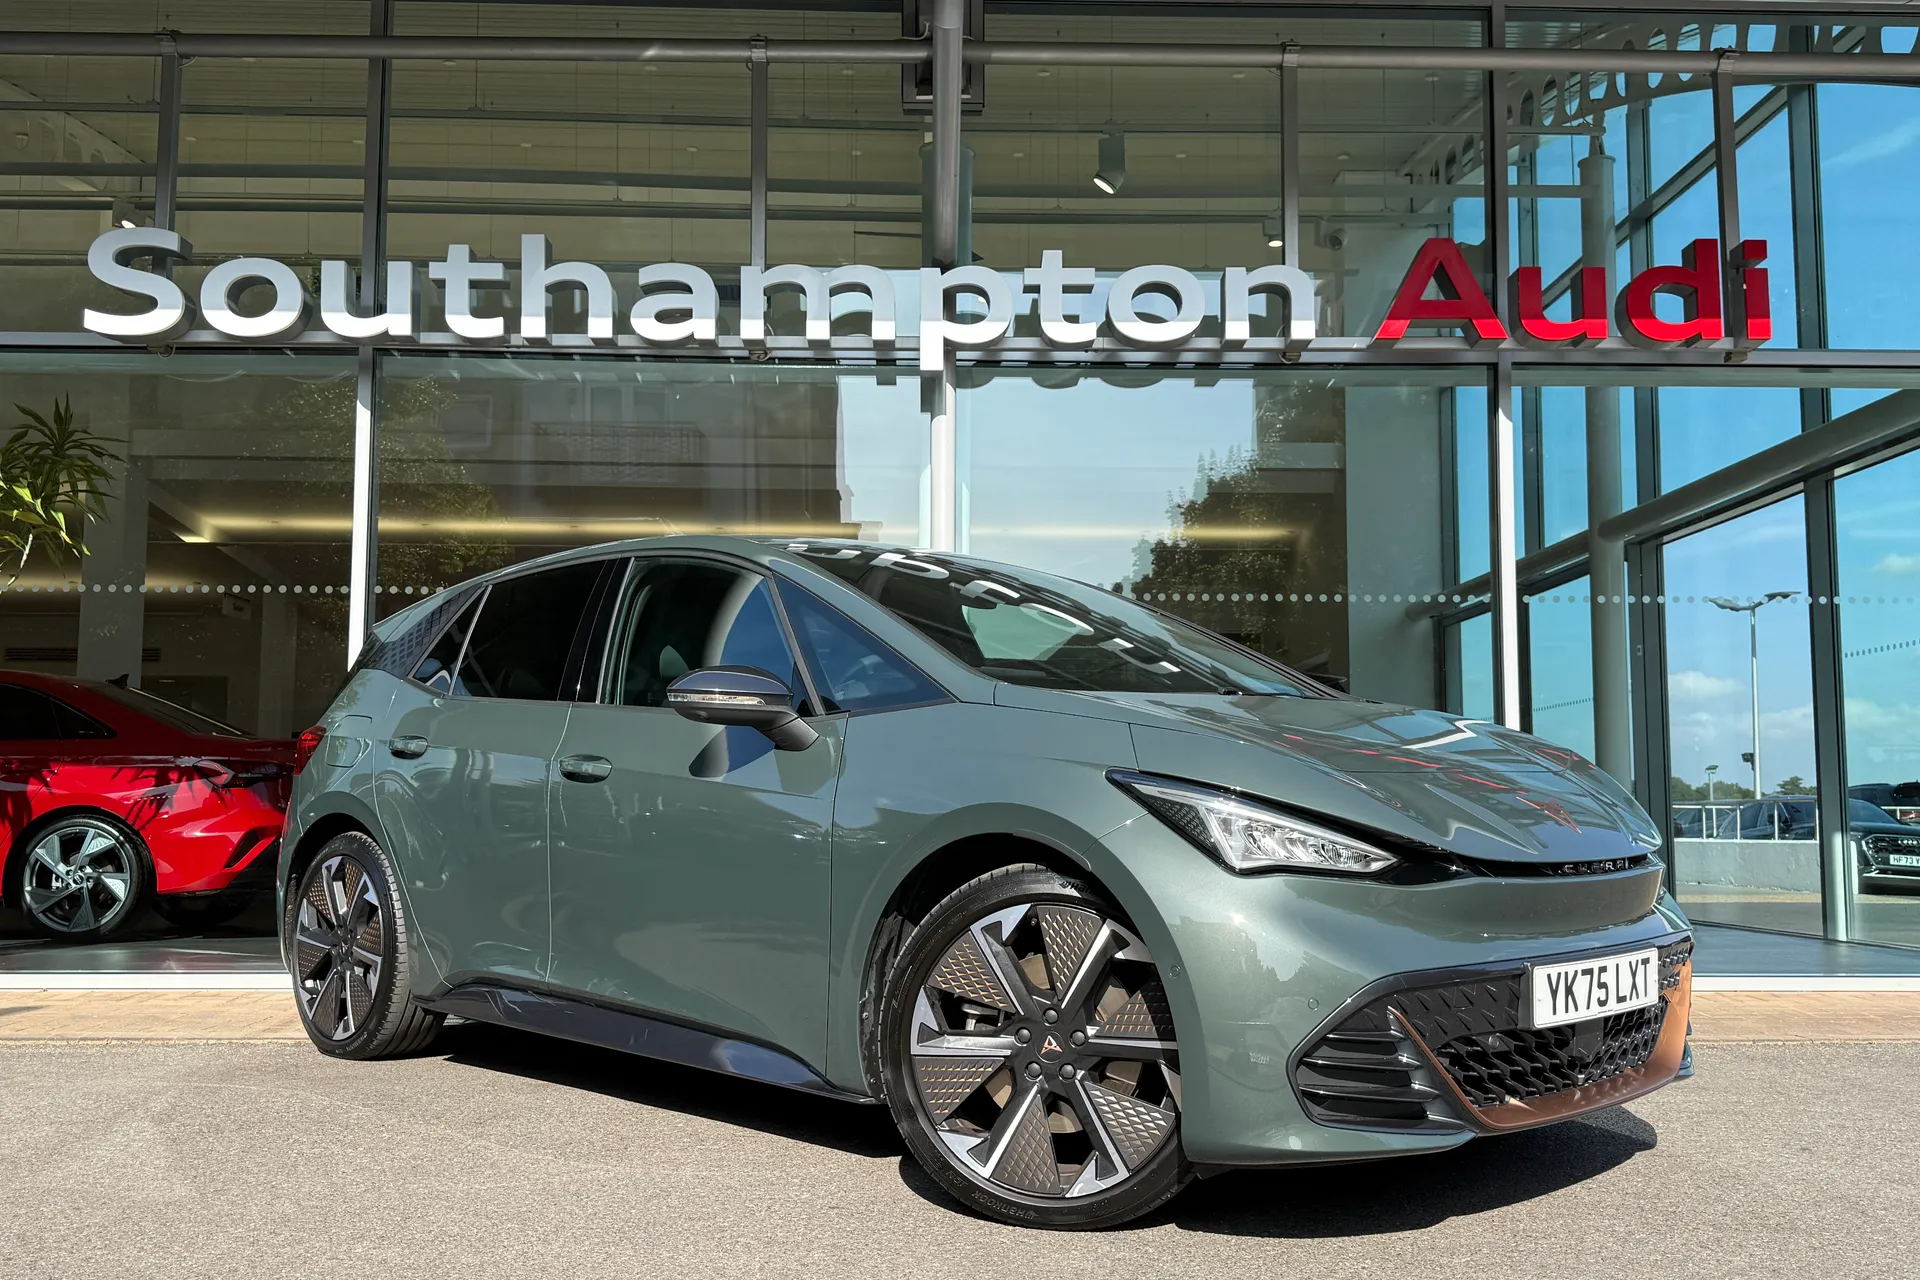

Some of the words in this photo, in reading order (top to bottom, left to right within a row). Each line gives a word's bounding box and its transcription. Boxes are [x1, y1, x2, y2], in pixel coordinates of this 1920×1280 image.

[83, 226, 1316, 371] Southampton
[1373, 237, 1772, 342] Audi
[1546, 965, 1610, 1016] YK75
[1615, 957, 1651, 1004] LXT
